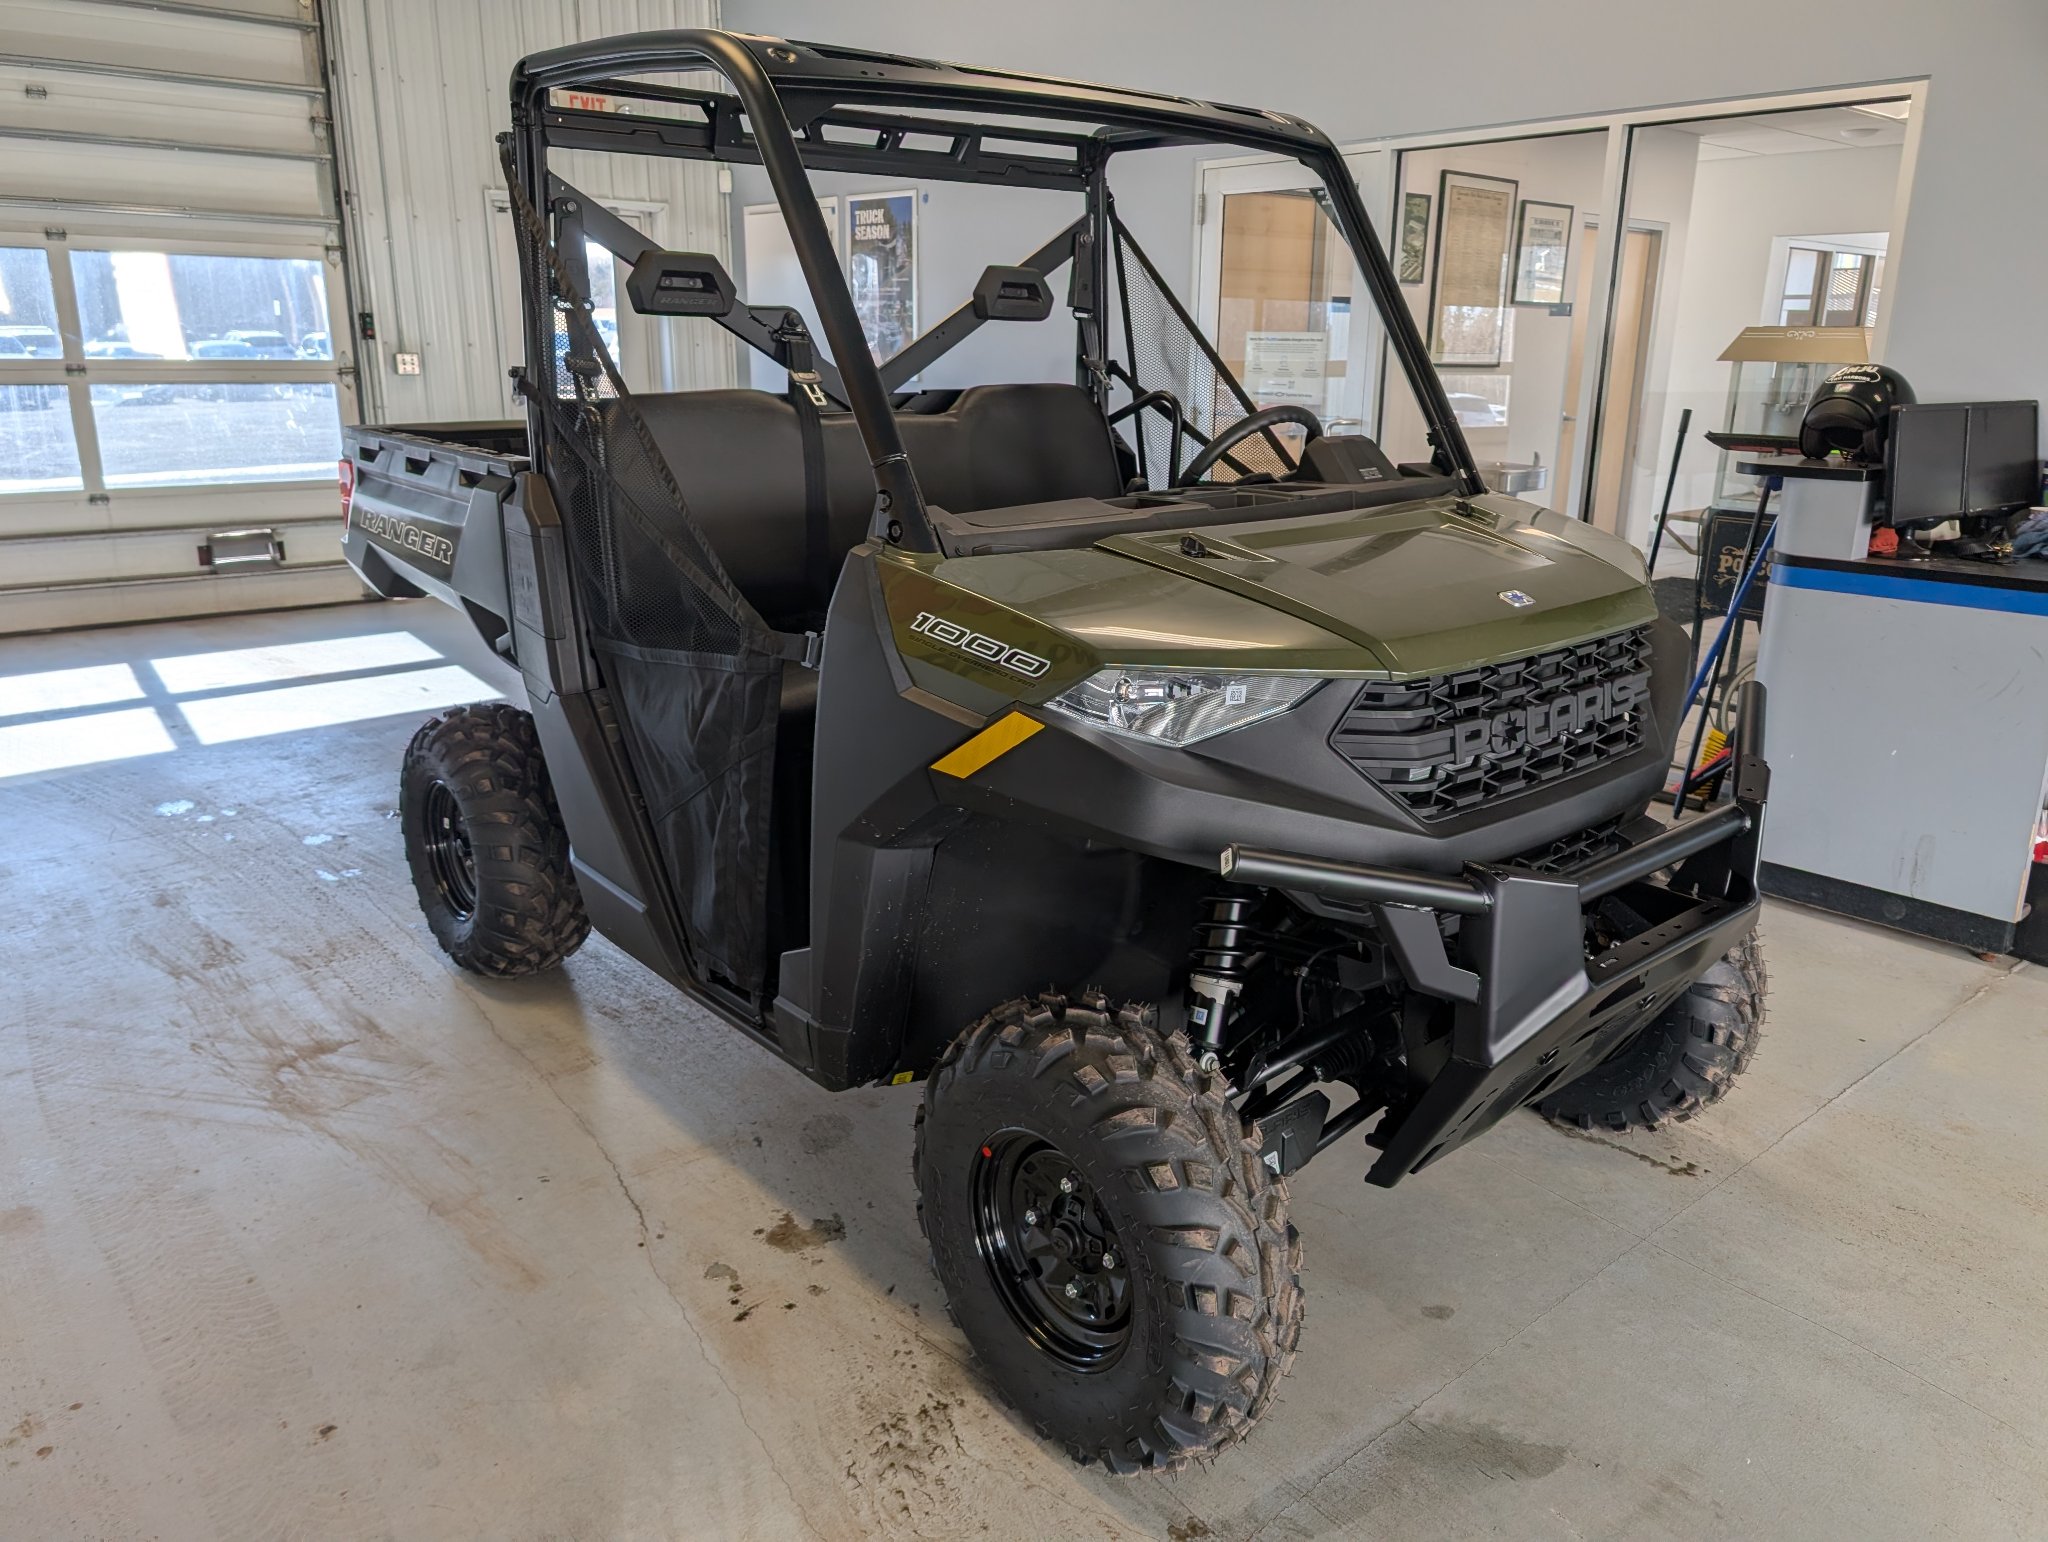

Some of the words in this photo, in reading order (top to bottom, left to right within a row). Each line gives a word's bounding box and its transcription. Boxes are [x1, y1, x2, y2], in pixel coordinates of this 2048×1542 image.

[855, 208, 885, 225] TRUCK
[855, 224, 890, 241] SEASON
[360, 507, 453, 565] RANGER
[908, 634, 947, 653] SINGLE
[949, 652, 1008, 677] OVERHEAD
[1009, 674, 1037, 689] CAM
[910, 611, 1051, 678] 1000
[1455, 675, 1642, 765] POLARIS
